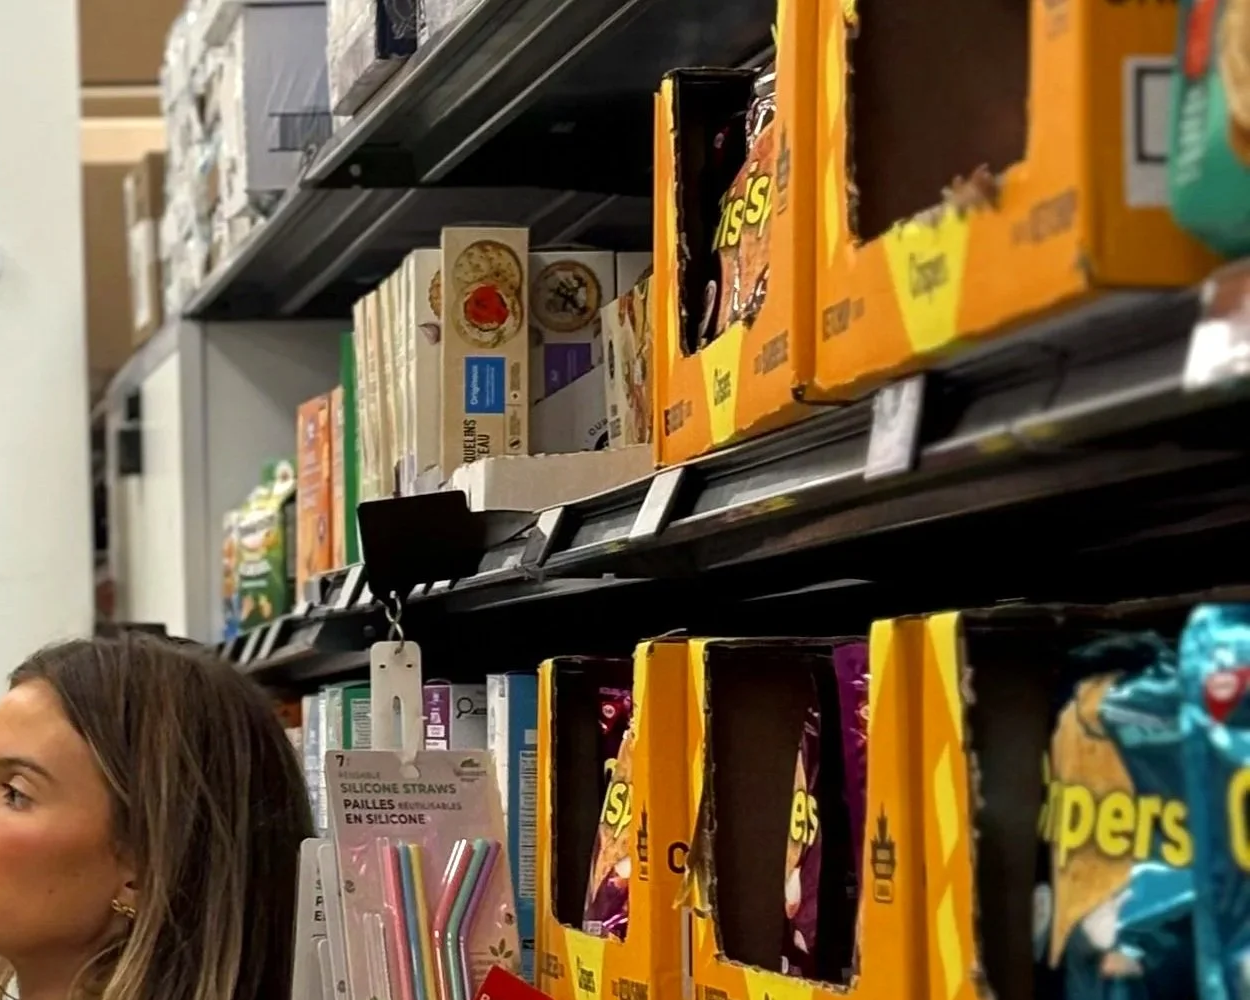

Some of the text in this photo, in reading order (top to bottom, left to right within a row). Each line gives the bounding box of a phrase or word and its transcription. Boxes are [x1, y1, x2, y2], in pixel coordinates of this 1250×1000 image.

[340, 782, 457, 795] SILICONE STRAWS
[343, 798, 395, 811] PAILLES
[345, 813, 427, 826] EN SILICONE
[1048, 780, 1194, 873] pers
